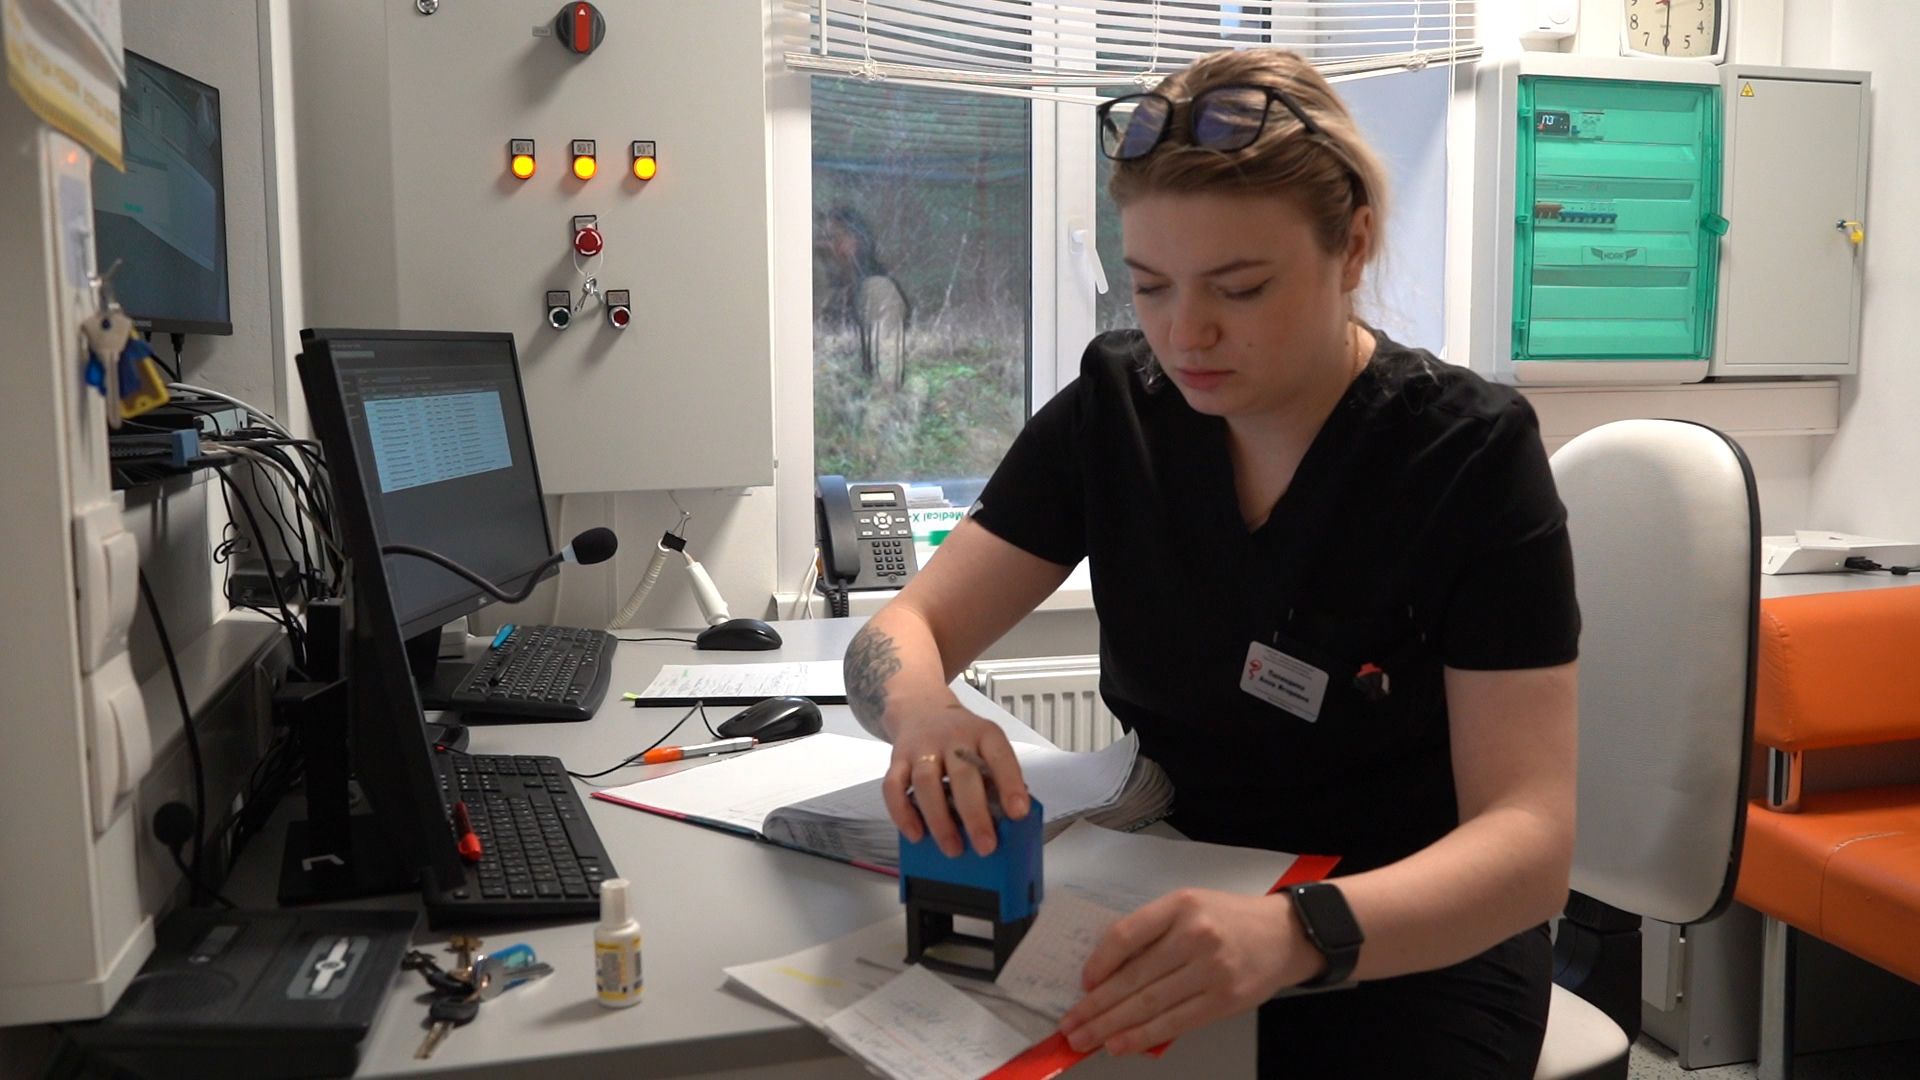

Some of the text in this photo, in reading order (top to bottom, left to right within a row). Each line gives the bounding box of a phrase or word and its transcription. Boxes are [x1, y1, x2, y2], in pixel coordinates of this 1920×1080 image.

[1629, 14, 1639, 30] 8
[1697, 21, 1705, 34] 4
[1642, 31, 1650, 47] 7
[1683, 35, 1691, 49] 5
[923, 512, 964, 522] Medical
